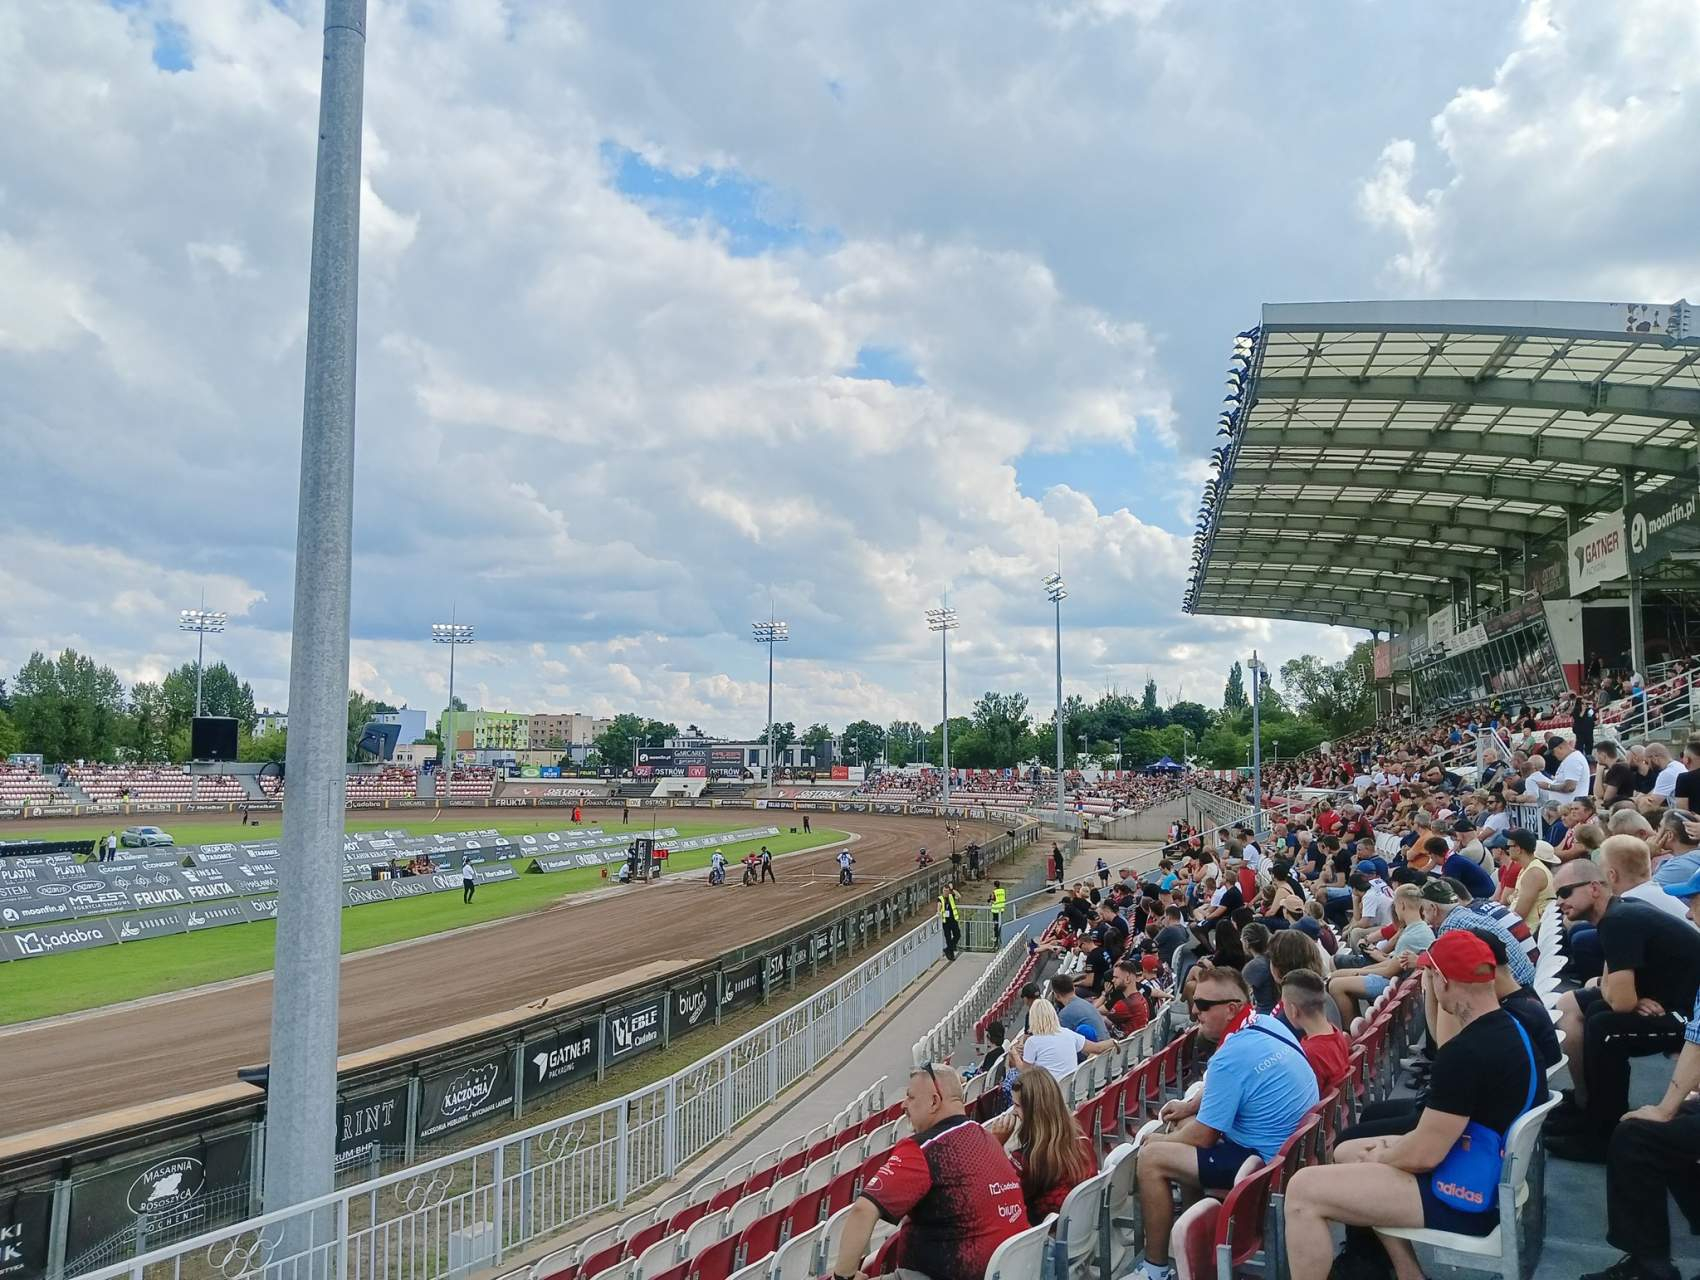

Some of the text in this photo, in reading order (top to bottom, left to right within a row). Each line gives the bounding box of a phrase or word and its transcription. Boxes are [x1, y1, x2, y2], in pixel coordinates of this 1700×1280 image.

[1649, 496, 1696, 534] moonfin.pl
[1585, 531, 1619, 563] GATNER
[2, 868, 37, 880] PLATIN
[54, 864, 86, 876] PLATIN
[133, 888, 184, 905] FRUKTA
[188, 882, 234, 898] FRUKTA
[69, 892, 127, 906] MALESA
[22, 904, 67, 917] moonfin.pl
[634, 1030, 657, 1046] Cadabra
[549, 1038, 591, 1068] GATNER
[549, 1062, 575, 1079] PACKAGING
[444, 1081, 488, 1108] KACZOCHA
[335, 1099, 394, 1141] RINT
[355, 1142, 373, 1154] BHP
[143, 1160, 192, 1185] MASARNIA
[1436, 1180, 1483, 1205] adidas
